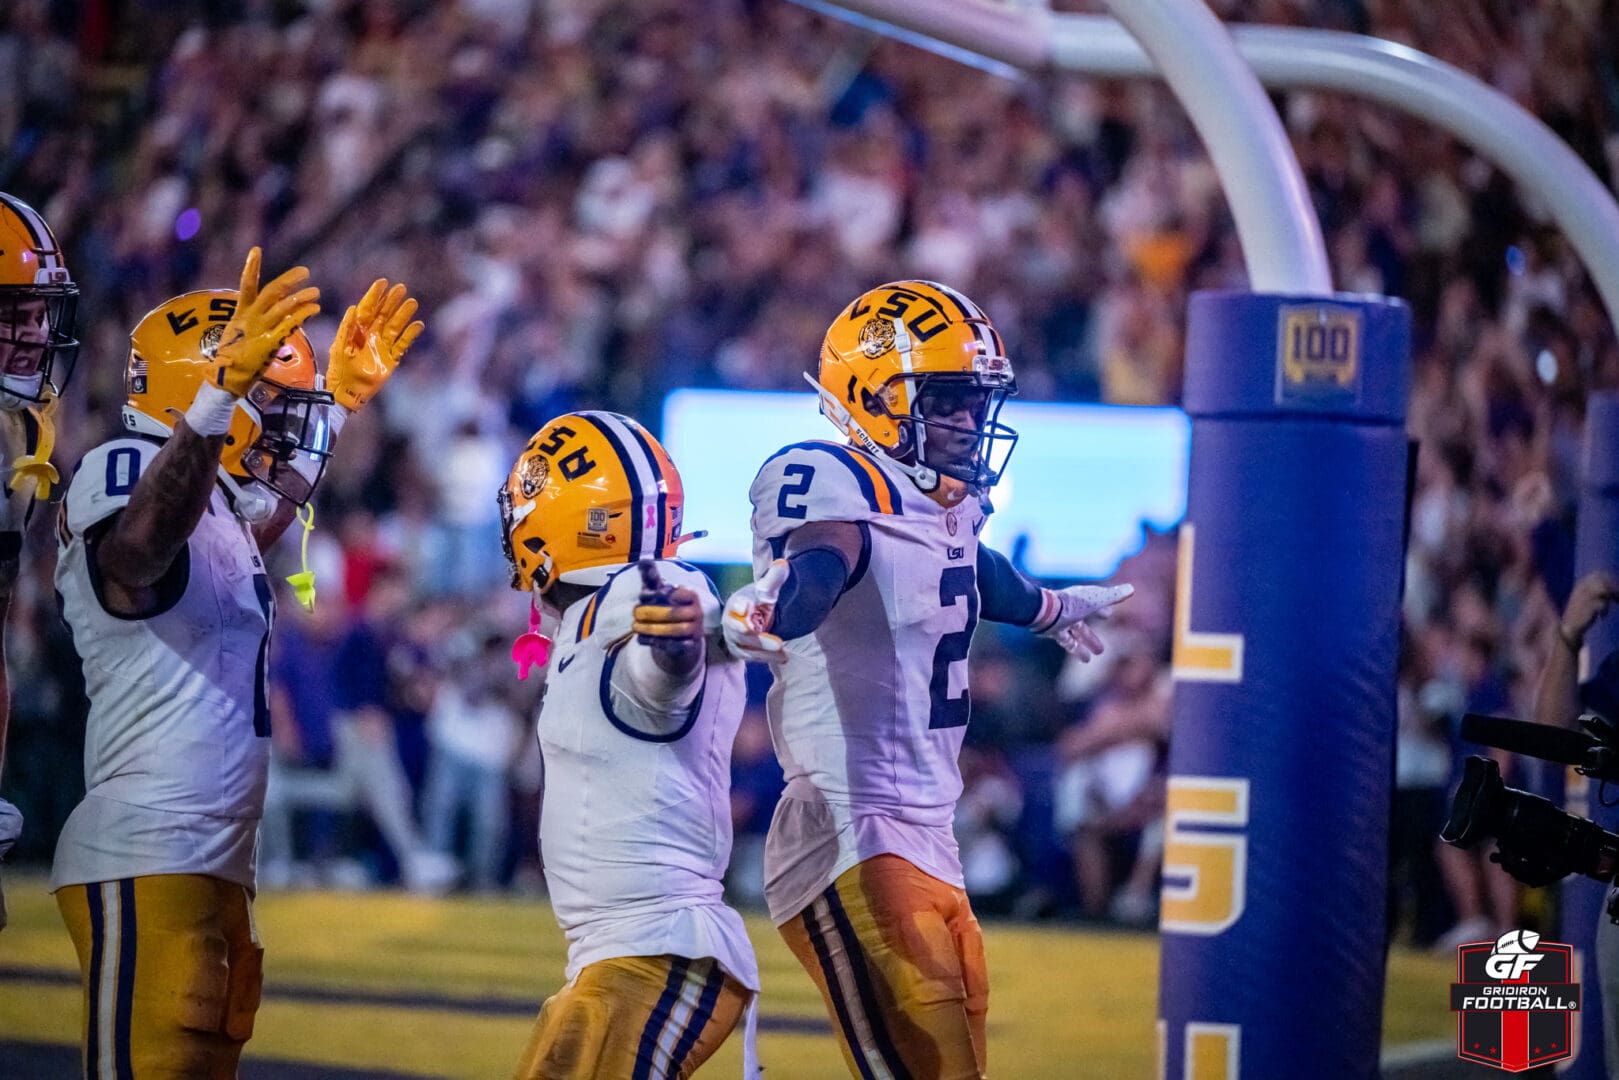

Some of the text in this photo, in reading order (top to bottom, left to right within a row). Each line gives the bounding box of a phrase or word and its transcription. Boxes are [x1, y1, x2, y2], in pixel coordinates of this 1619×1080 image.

[166, 299, 238, 336] LS
[850, 292, 949, 342] LSU
[1293, 325, 1349, 361] 100
[105, 447, 141, 496] 0
[777, 464, 815, 519] 2
[590, 511, 605, 521] 100
[947, 546, 964, 560] LSU
[929, 565, 981, 730] 2
